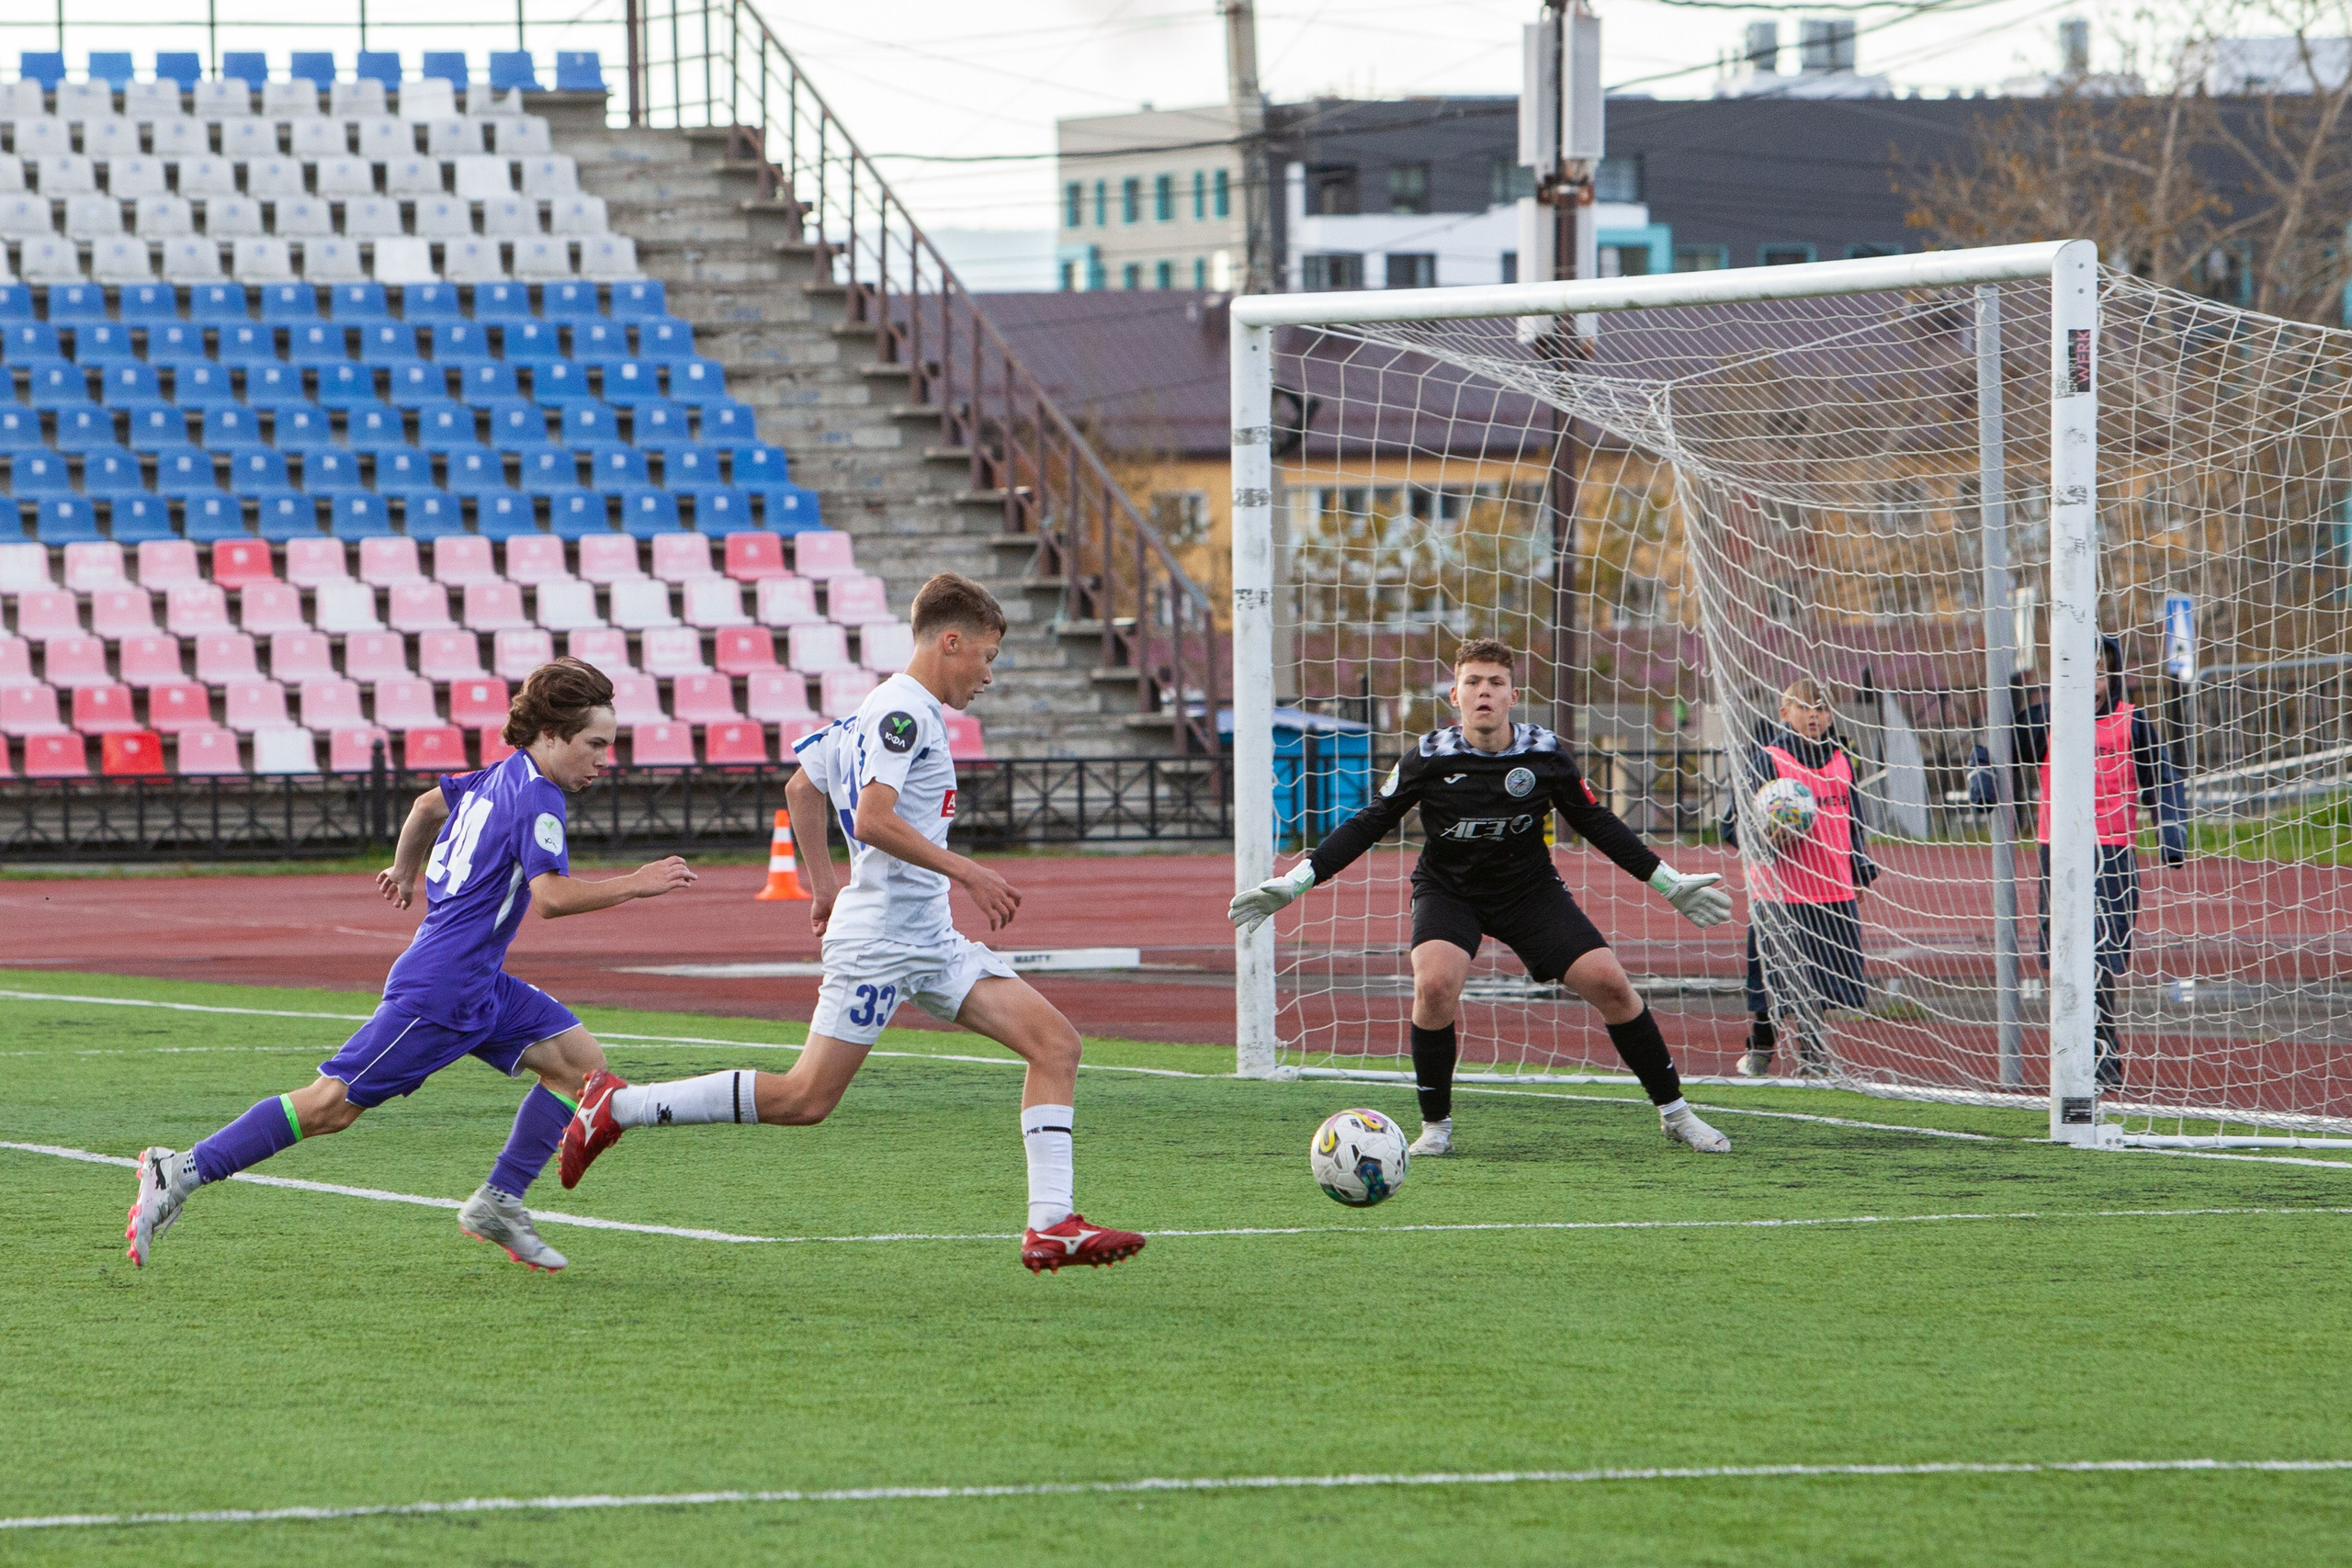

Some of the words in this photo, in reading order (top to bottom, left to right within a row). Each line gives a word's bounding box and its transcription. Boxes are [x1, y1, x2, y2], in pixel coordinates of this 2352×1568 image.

[2076, 330, 2090, 383] WERK
[885, 731, 905, 748] ЮФЛ
[850, 984, 897, 1027] 33
